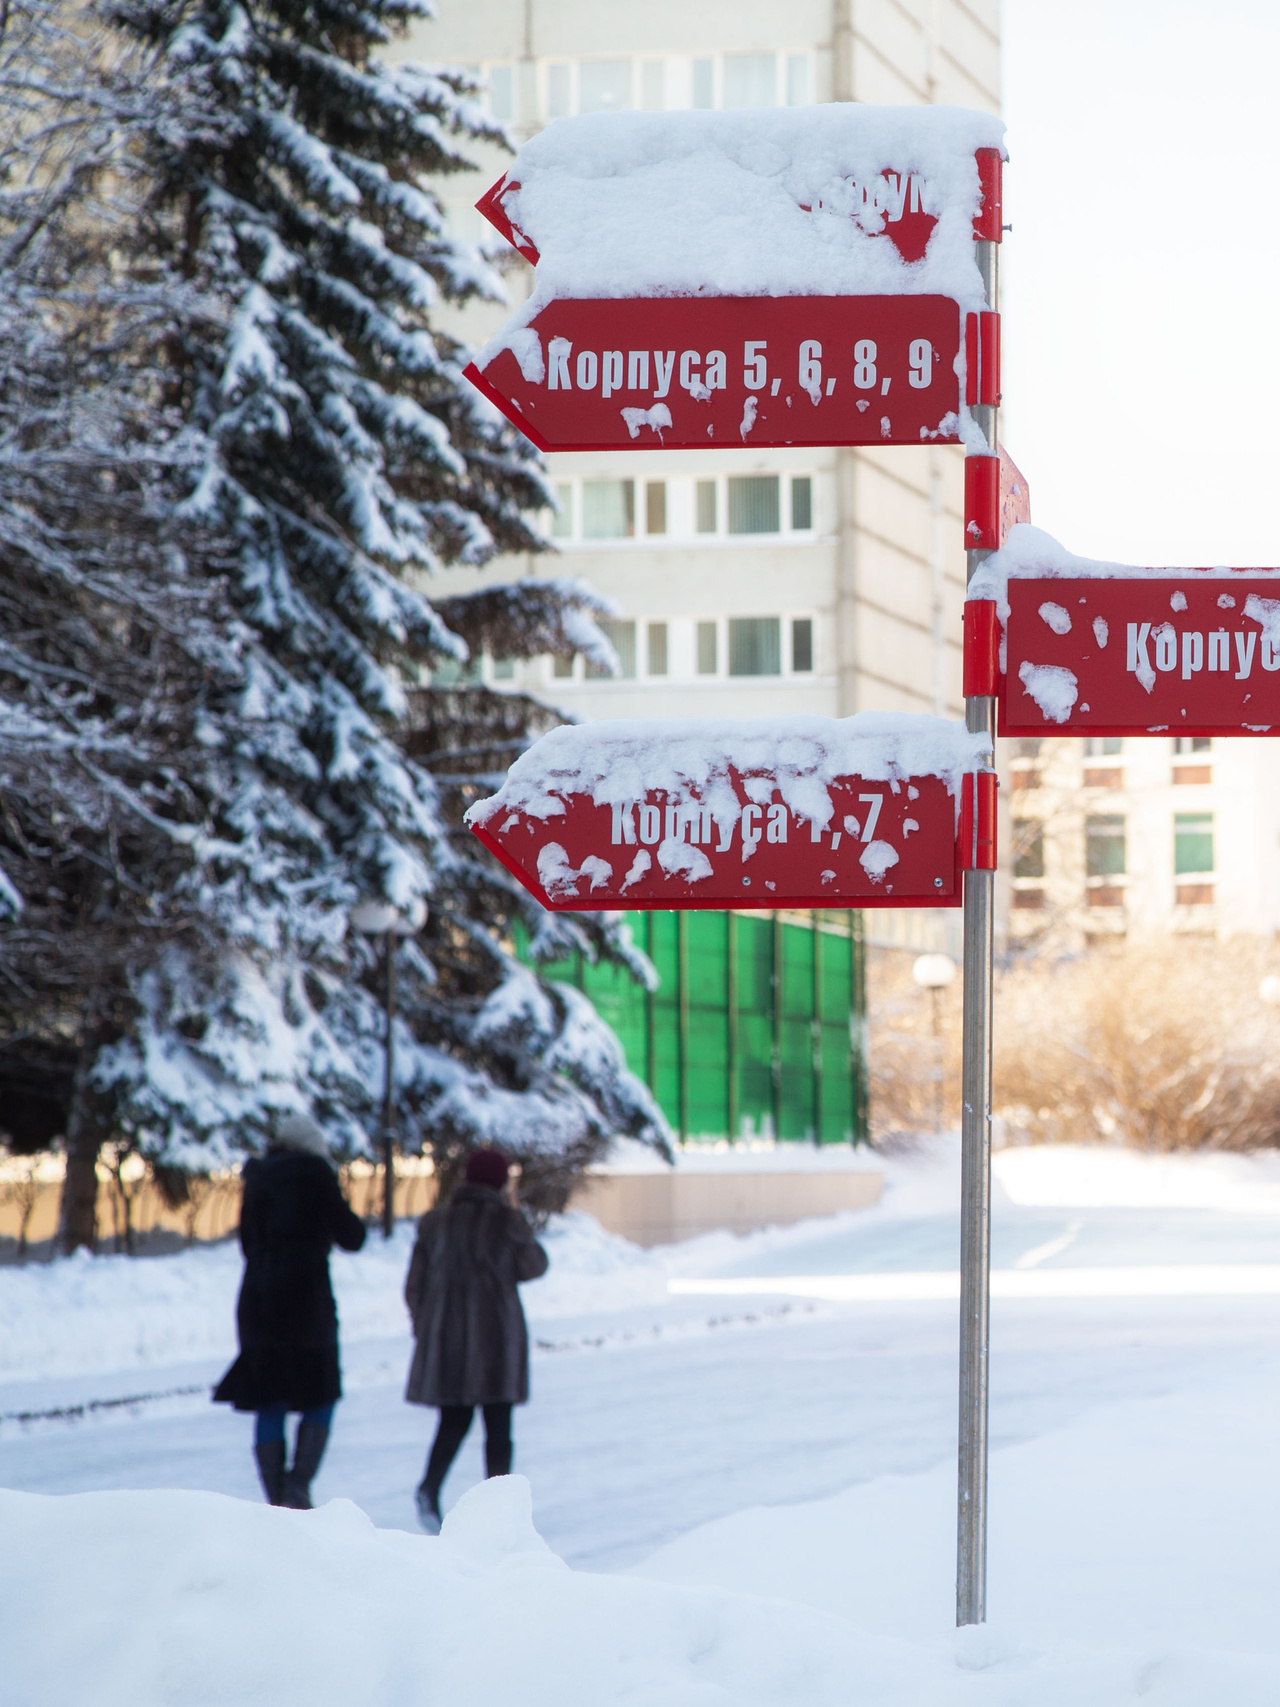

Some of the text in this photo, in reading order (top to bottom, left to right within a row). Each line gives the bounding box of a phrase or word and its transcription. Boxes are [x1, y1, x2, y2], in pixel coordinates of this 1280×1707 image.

[548, 338, 933, 398] Корпуса 5, 6, 8, 9
[610, 797, 788, 853] Корпуса
[857, 793, 884, 843] 7
